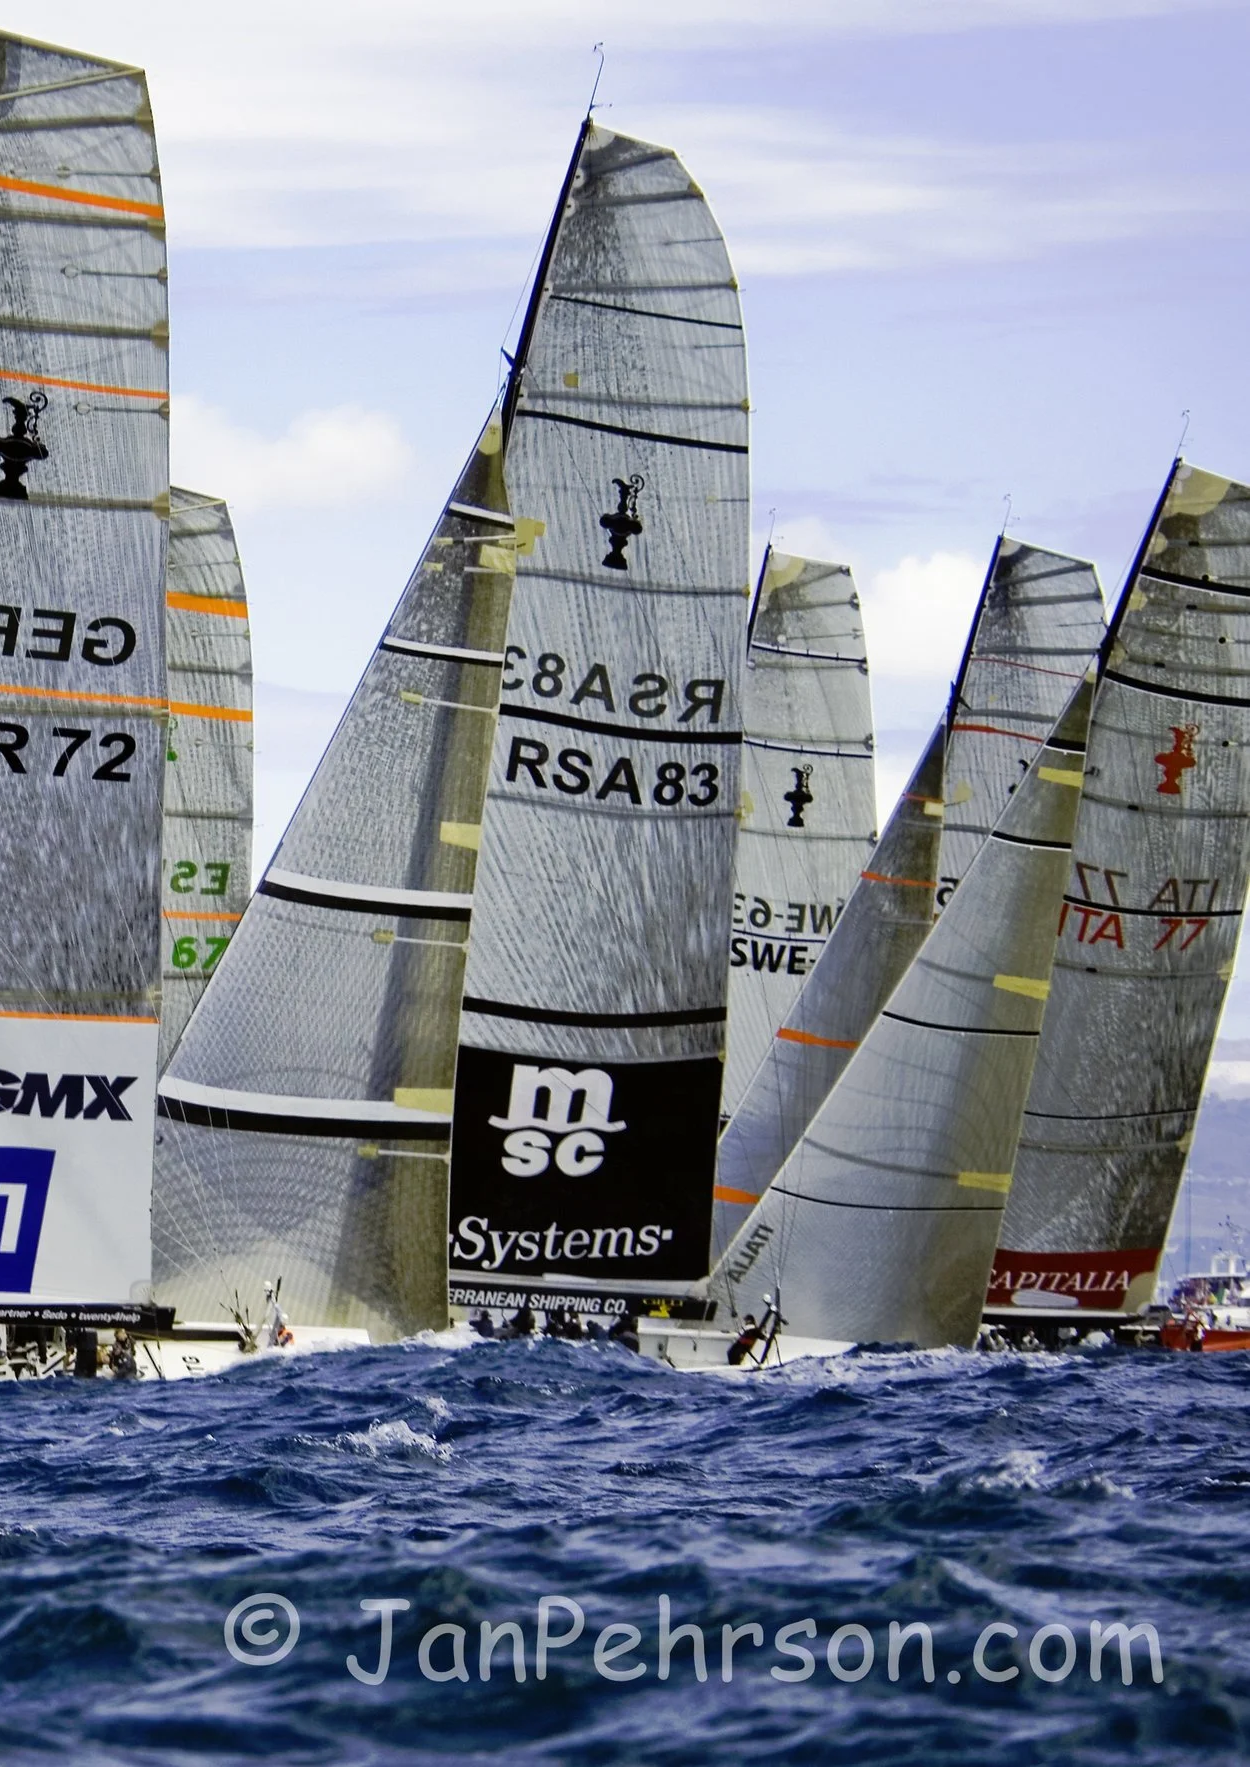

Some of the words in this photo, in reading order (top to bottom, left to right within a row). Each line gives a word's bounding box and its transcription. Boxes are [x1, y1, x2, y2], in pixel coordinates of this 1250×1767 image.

[52, 727, 136, 782] 72
[1058, 903, 1124, 949] ITA
[529, 1294, 601, 1313] SHIPPING
[603, 1299, 629, 1315] CO.
